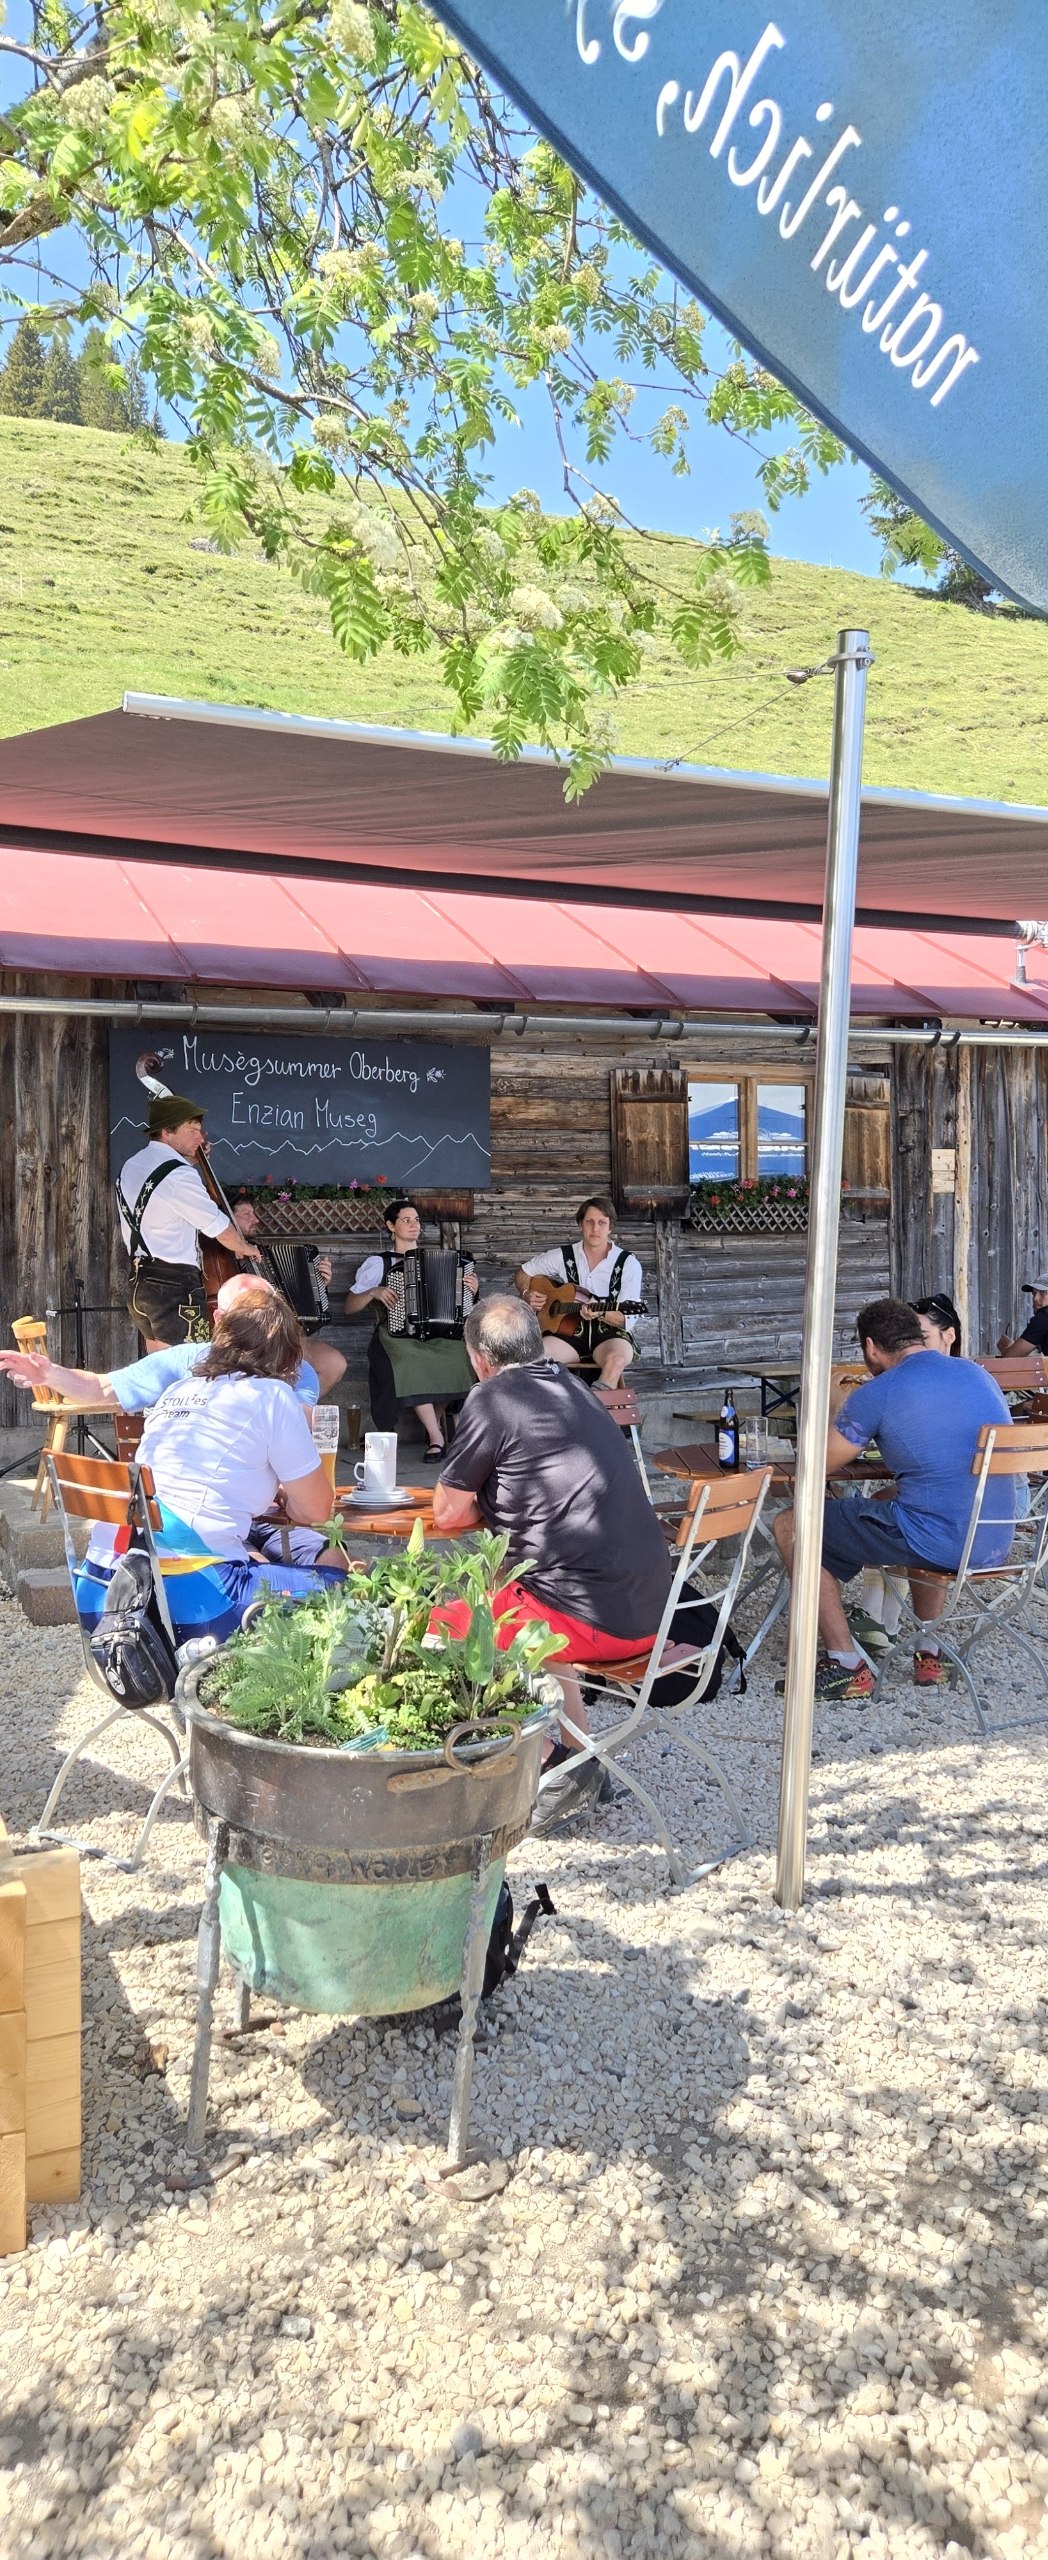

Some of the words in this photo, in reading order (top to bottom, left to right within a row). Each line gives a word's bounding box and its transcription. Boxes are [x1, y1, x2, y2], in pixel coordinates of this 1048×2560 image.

[349, 1051, 421, 1093] Oberberg
[231, 1092, 304, 1130] Enzian
[315, 1097, 378, 1137] Museg
